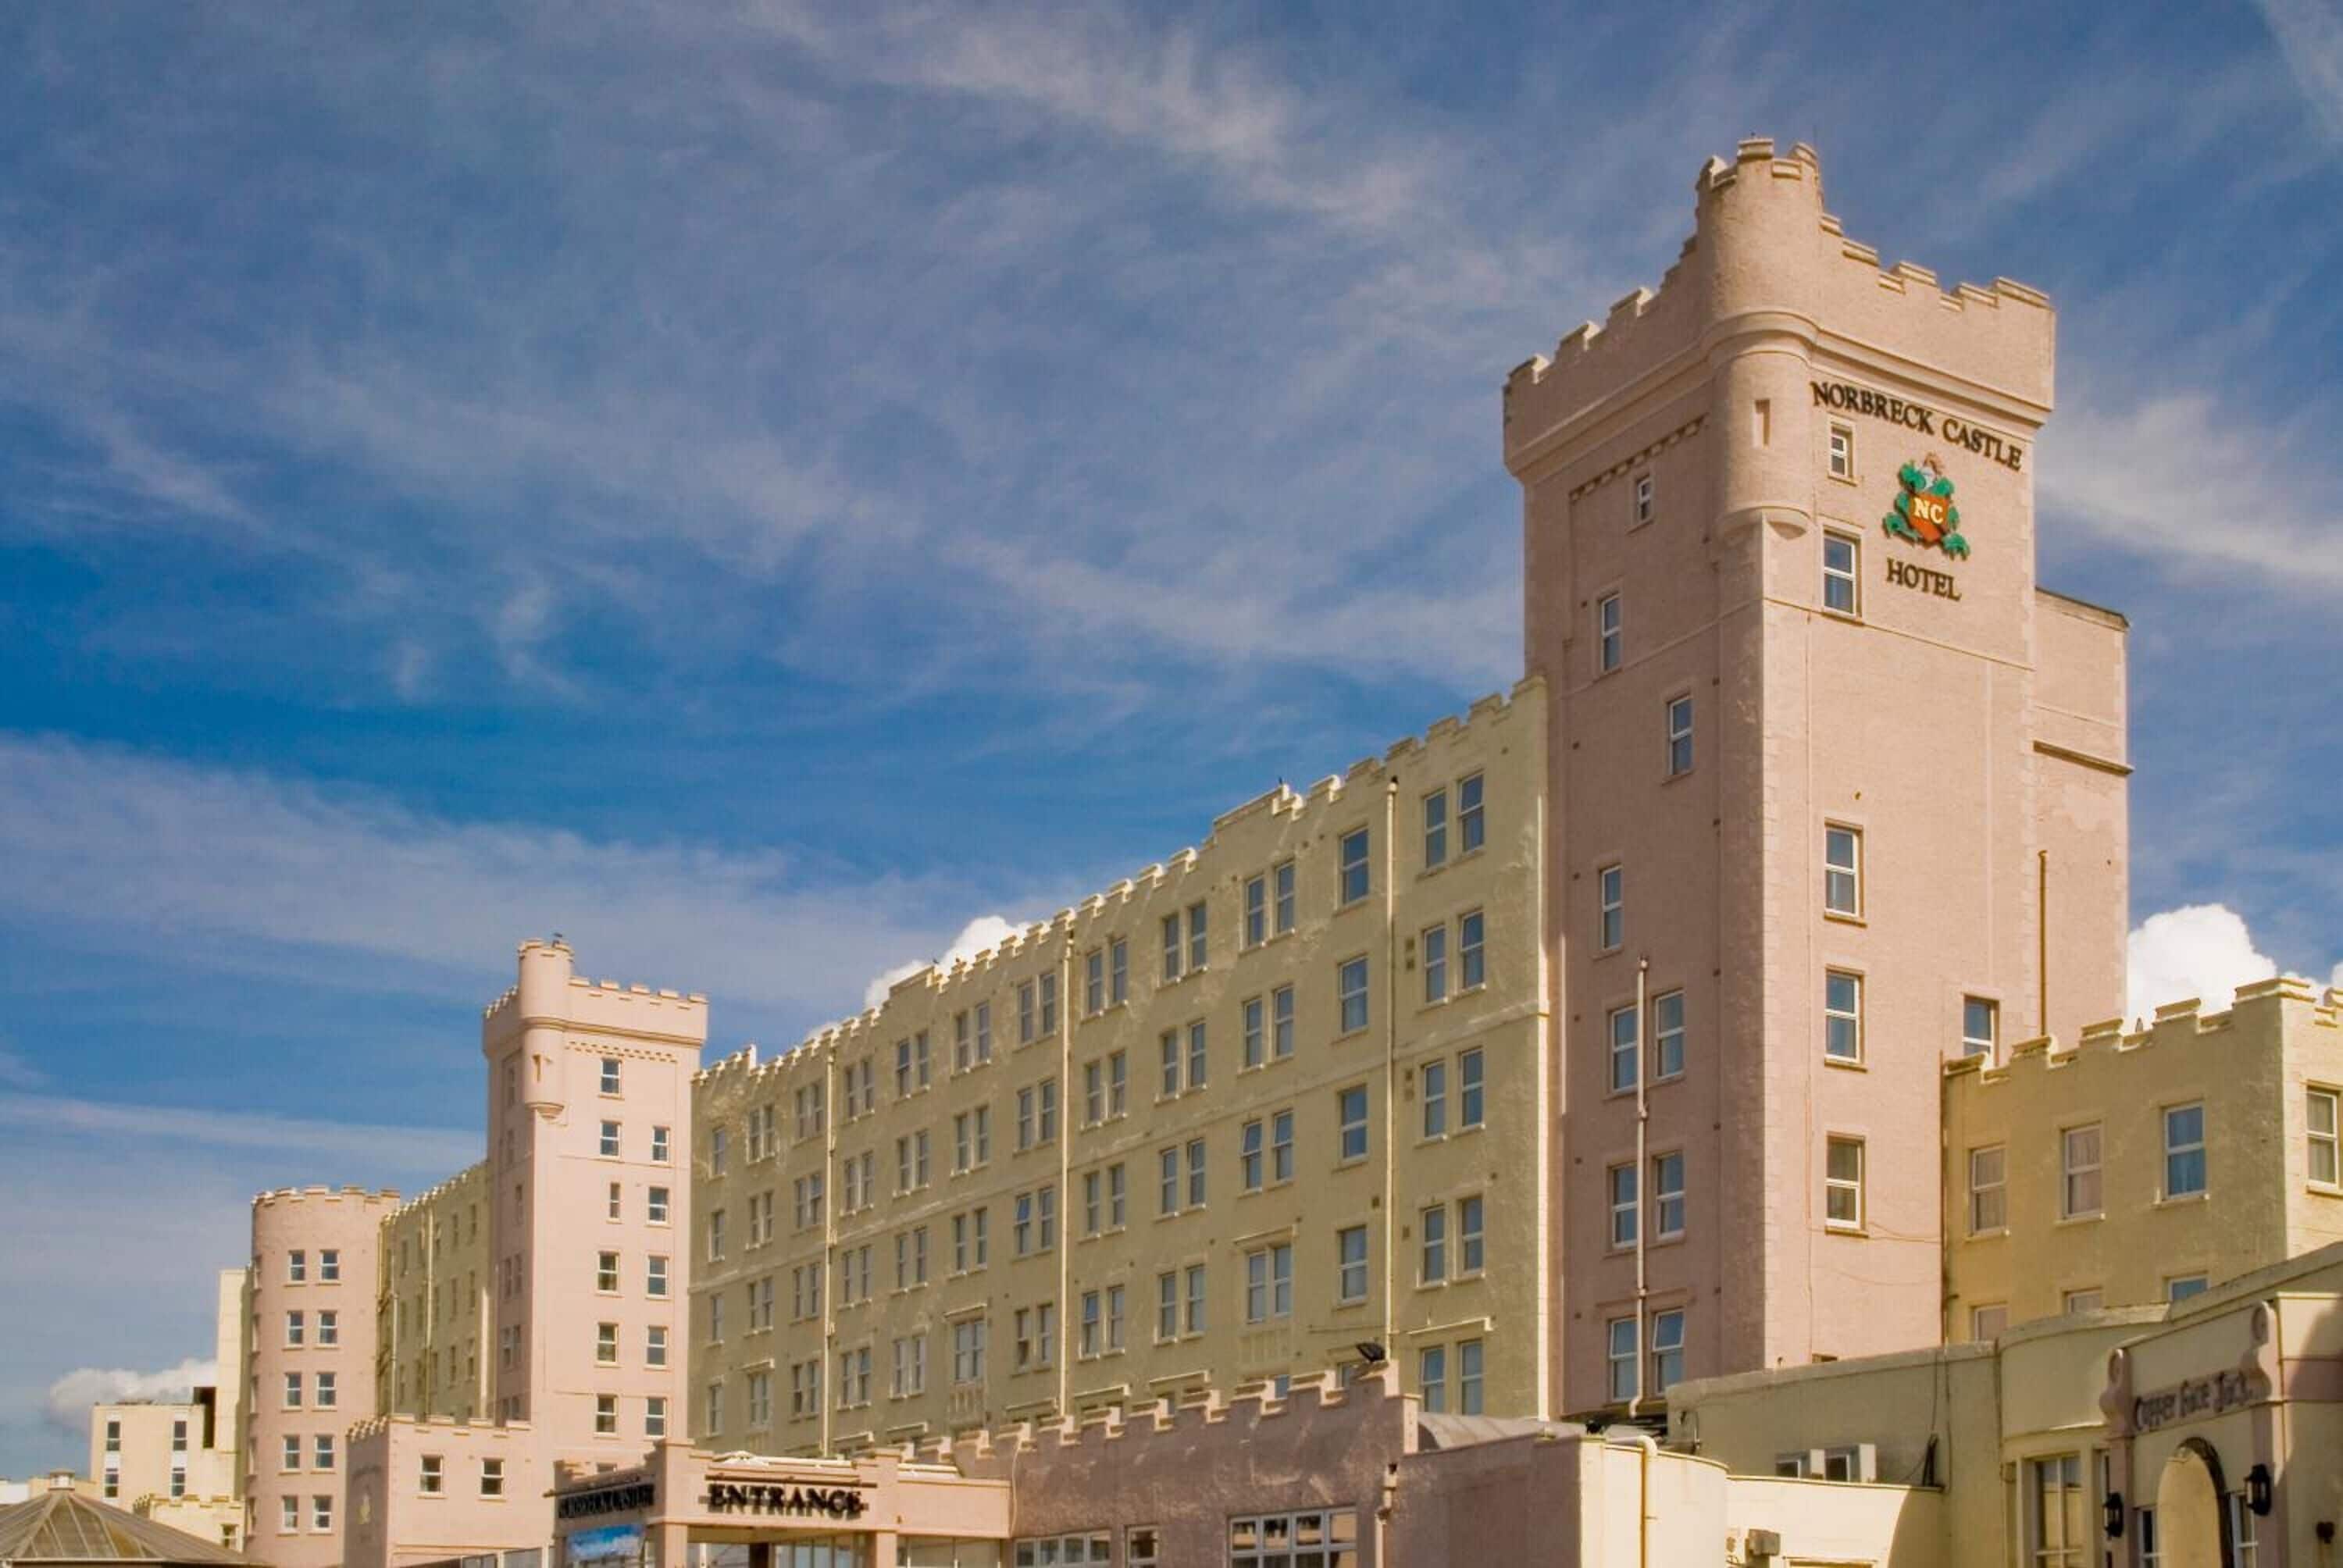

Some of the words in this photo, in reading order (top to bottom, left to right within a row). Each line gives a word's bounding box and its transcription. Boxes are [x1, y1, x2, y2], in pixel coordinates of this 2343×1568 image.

[1810, 381, 1935, 436] NORBRECK
[1942, 419, 2023, 472] CASTLE
[1914, 498, 1945, 524] NC
[1886, 558, 1962, 601] HOTEL
[708, 1483, 862, 1516] ENTRANCE
